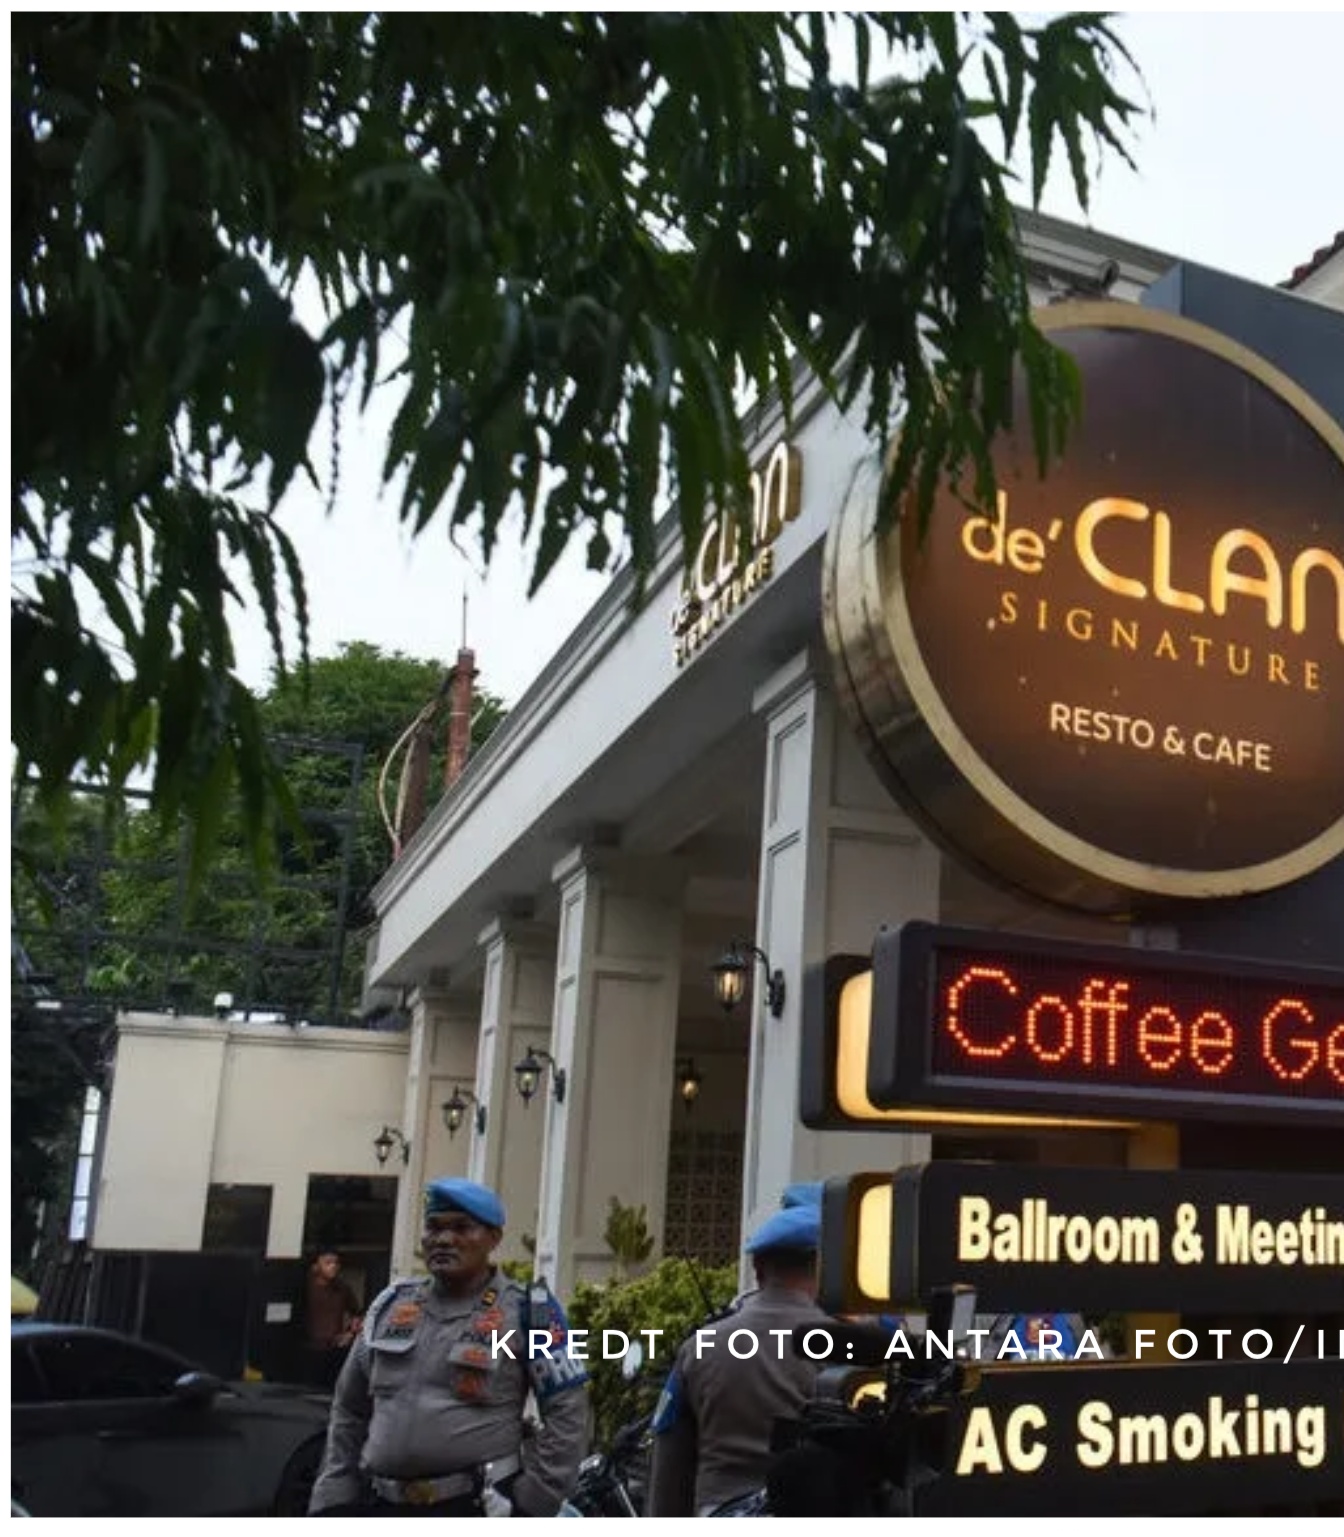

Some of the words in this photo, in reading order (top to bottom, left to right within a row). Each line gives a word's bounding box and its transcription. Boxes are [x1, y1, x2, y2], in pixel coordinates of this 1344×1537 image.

[1000, 591, 1320, 691] SIGNATURE
[1049, 701, 1156, 750] RESTO
[1162, 726, 1187, 757] &
[1193, 731, 1272, 773] CAFE
[947, 967, 1234, 1074] Coffee
[959, 1197, 1160, 1264] Ballroom
[1172, 1202, 1204, 1265] &
[956, 1404, 1047, 1475] AC
[1076, 1394, 1325, 1467] Smoking
